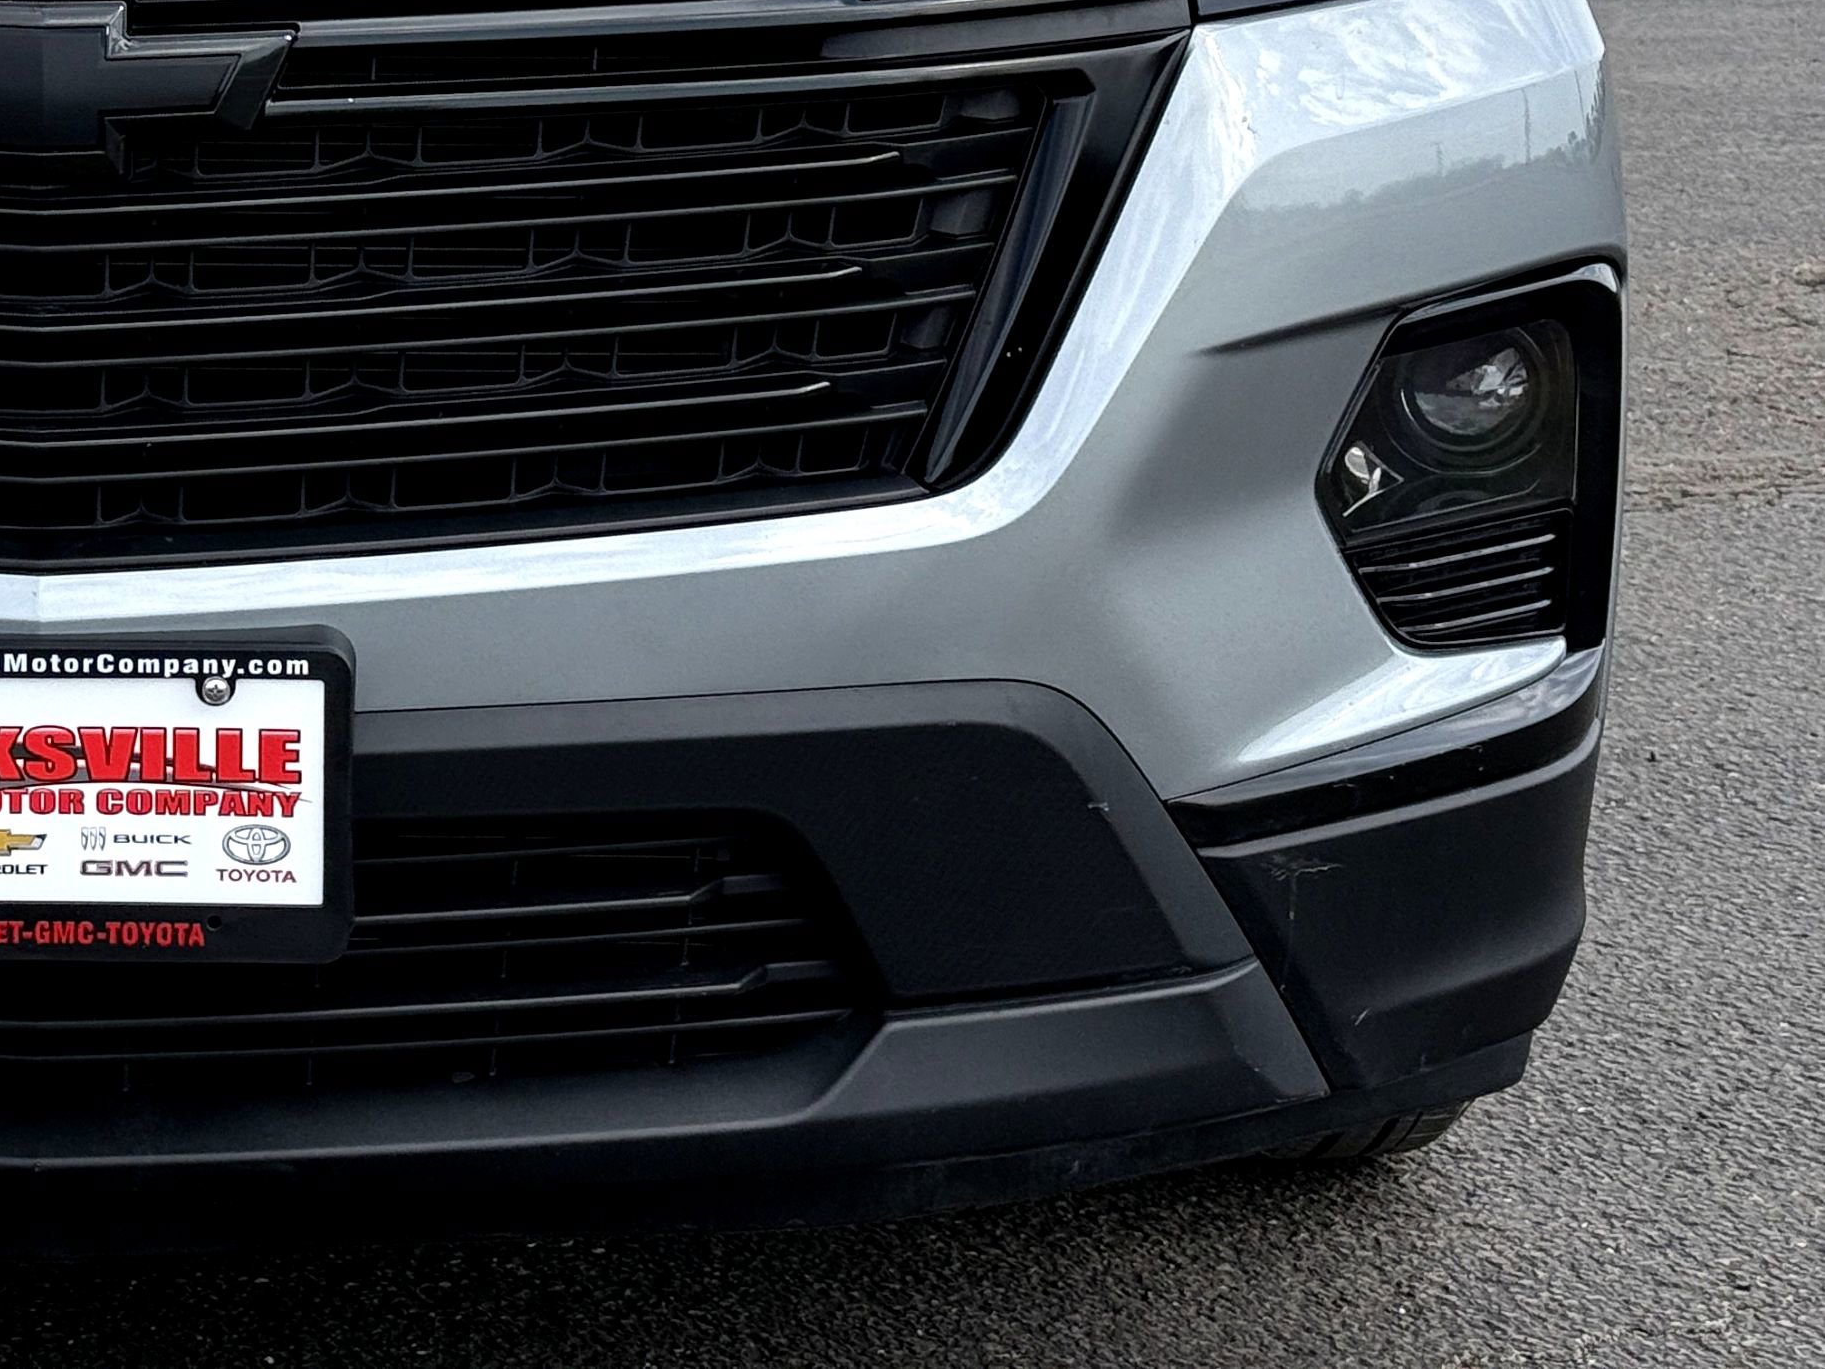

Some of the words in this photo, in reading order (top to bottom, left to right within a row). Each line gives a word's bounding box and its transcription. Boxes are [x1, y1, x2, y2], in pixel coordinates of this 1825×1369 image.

[96, 788, 302, 817] COMPANY
[113, 834, 192, 846] BUICK
[79, 860, 188, 877] GMC
[216, 868, 297, 883] TOYOTA
